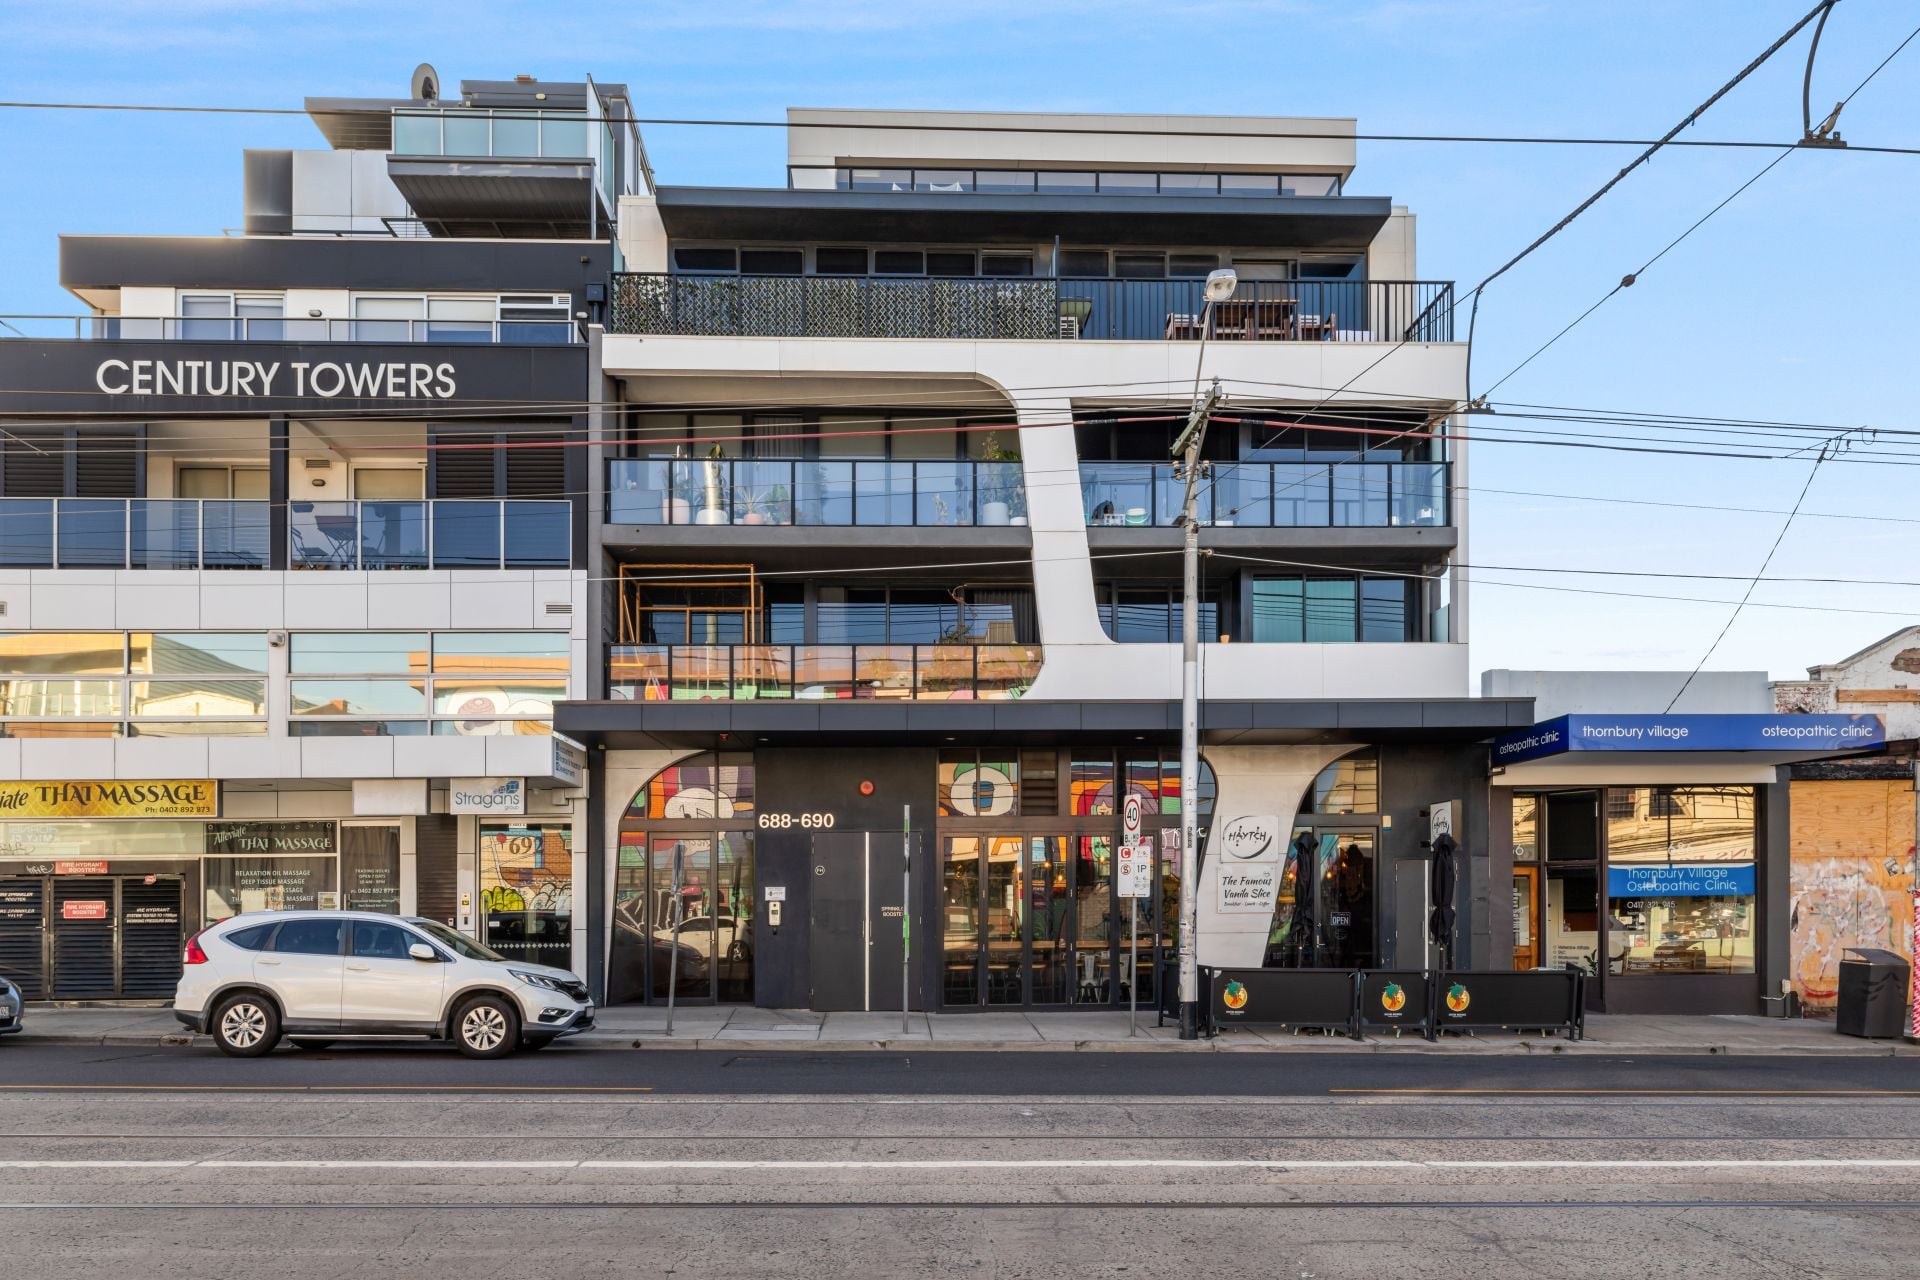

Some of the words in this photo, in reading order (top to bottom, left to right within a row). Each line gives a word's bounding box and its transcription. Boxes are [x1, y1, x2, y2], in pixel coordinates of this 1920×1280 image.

[96, 359, 280, 396] CENTURY
[291, 362, 456, 398] TOWERS
[1582, 725, 1644, 739] thornbury
[1646, 725, 1689, 739] village
[1762, 725, 1838, 739] osteopathic
[1840, 725, 1873, 738] clinic
[1499, 734, 1540, 755] osteopathic
[1540, 730, 1560, 746] clinic
[34, 783, 92, 805] THAI
[96, 783, 206, 805] MASSAGE
[455, 791, 520, 808] Stragans
[758, 813, 834, 828] 688-690
[1127, 807, 1138, 822] 40
[214, 824, 247, 845] Alleviate
[1229, 828, 1266, 843] HAYTCH
[238, 836, 269, 850] THAI
[274, 836, 333, 851] MASSAGE
[1137, 864, 1147, 873] 1P
[1627, 868, 1688, 880] Thornbury
[1688, 867, 1728, 880] Village
[1222, 875, 1237, 886] The
[1240, 876, 1272, 886] Famous
[1627, 880, 1700, 892] Osteopathic
[1704, 879, 1737, 891] Clinic
[1250, 887, 1271, 899] Slice
[1332, 916, 1349, 925] OPEN
